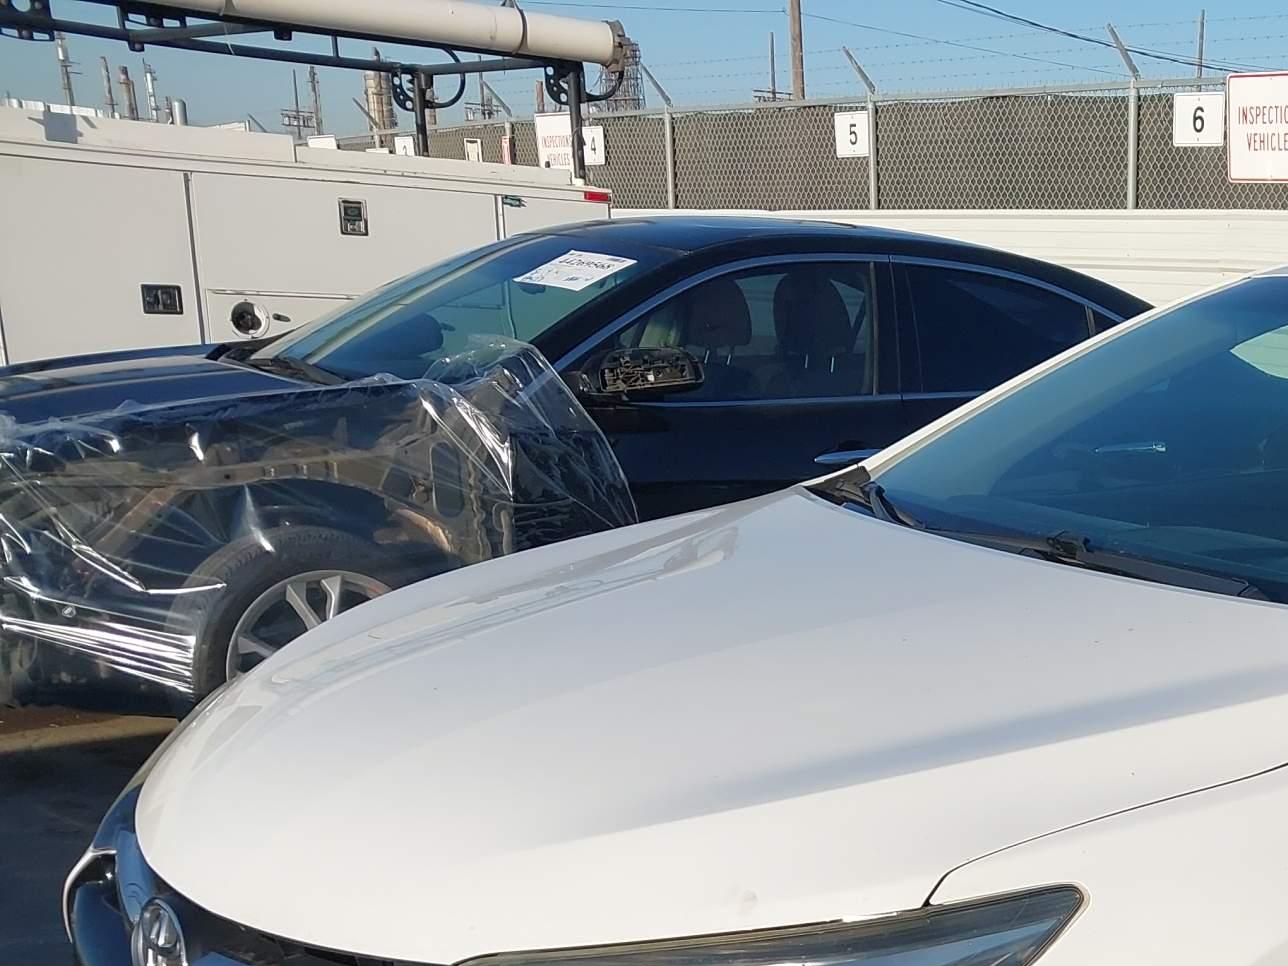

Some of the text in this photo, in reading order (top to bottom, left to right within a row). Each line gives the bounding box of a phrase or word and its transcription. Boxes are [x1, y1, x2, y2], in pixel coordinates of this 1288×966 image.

[1192, 106, 1205, 133] 6
[590, 136, 597, 155] 4
[849, 123, 858, 146] 5
